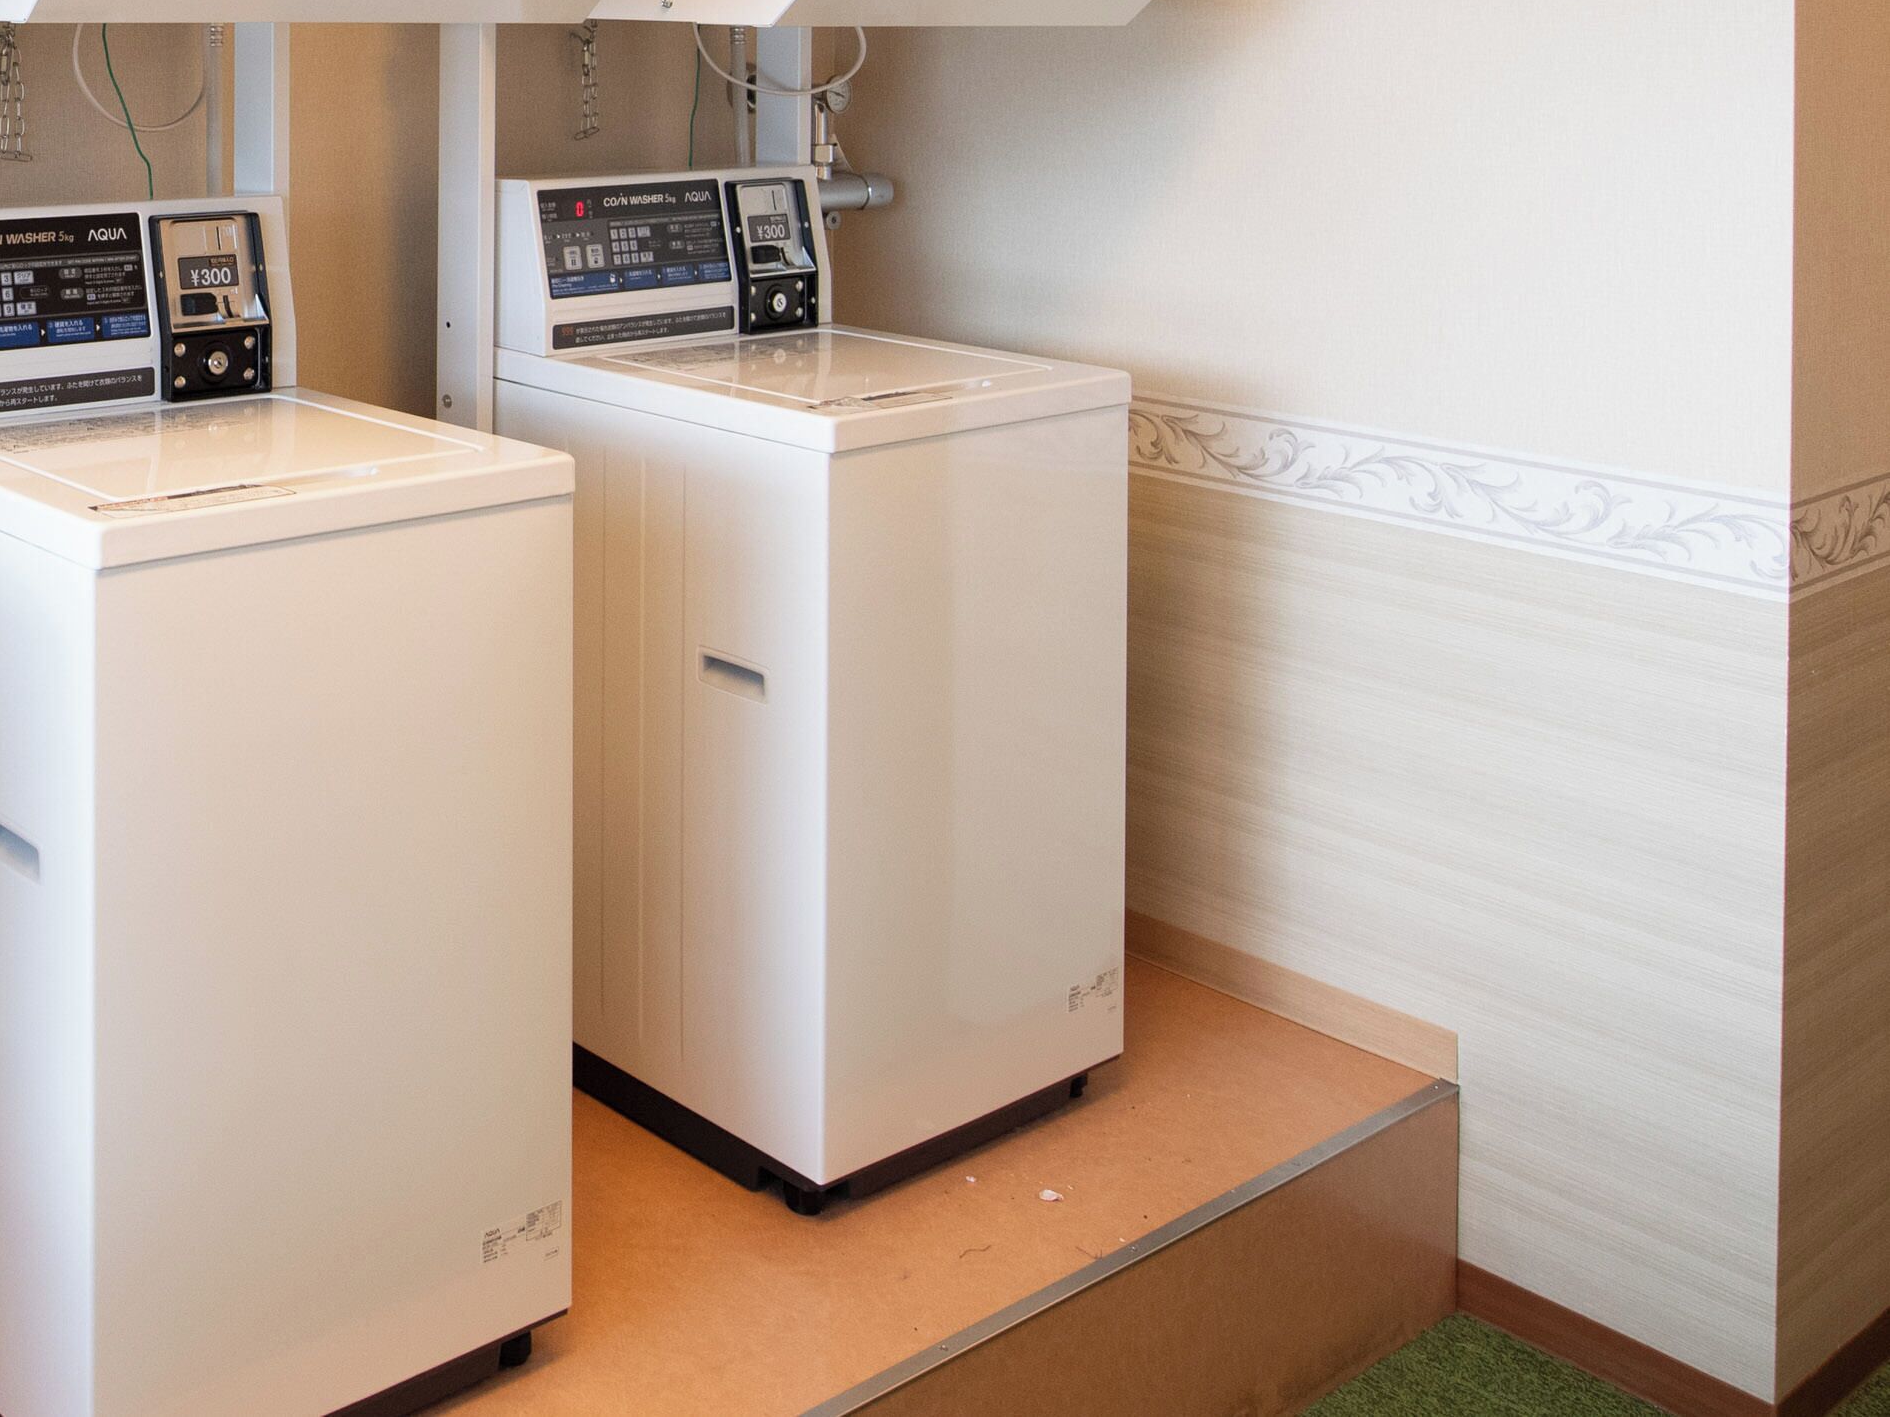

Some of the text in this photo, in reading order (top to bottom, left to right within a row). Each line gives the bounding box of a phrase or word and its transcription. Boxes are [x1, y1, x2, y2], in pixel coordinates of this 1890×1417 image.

[629, 194, 664, 205] WASHER
[684, 190, 712, 203] AQUA
[6, 231, 57, 244] WASHER
[87, 227, 128, 242] AQUA
[756, 223, 786, 240] ¥300
[190, 267, 231, 287] ¥300
